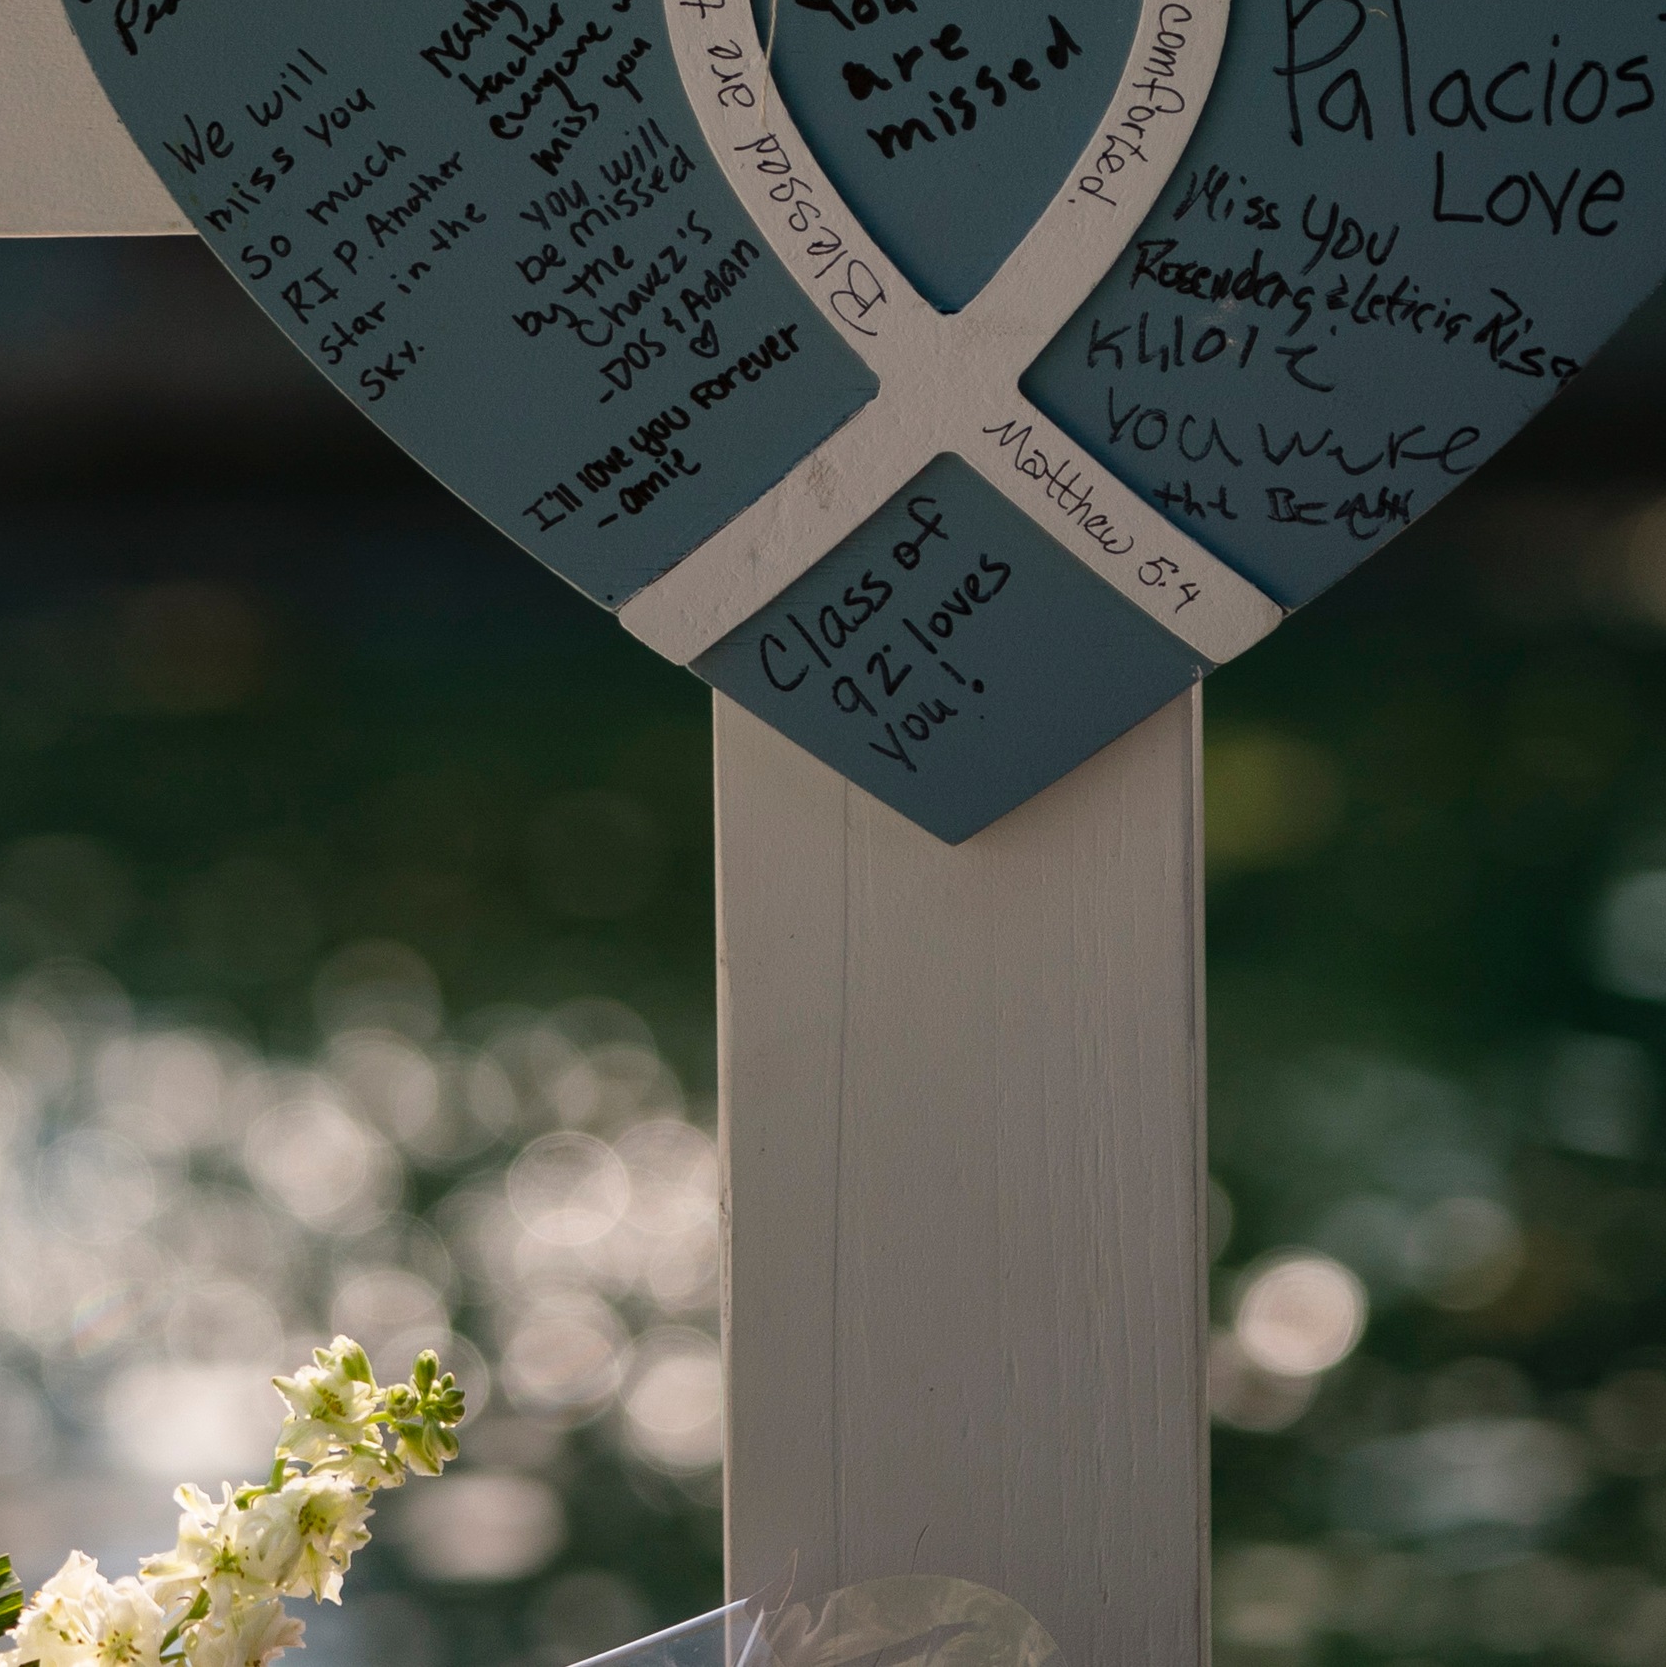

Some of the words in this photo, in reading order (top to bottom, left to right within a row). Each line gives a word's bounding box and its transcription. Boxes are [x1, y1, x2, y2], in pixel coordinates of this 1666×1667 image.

[601, 36, 653, 104] you
[706, 38, 766, 108] are
[841, 23, 970, 101] are
[865, 13, 1085, 160] missed
[162, 113, 235, 174] We
[245, 47, 329, 128] will
[598, 117, 670, 185] will
[204, 146, 296, 233] miss
[305, 140, 407, 226] much
[366, 150, 464, 249] Another
[514, 242, 567, 285] be
[568, 143, 698, 248] missed
[1171, 163, 1283, 233] Miss
[1433, 149, 1626, 237] Love
[389, 260, 432, 295] in
[431, 202, 488, 252] the
[733, 131, 888, 337] Blessed
[510, 302, 581, 337] by
[561, 244, 634, 299] the
[521, 481, 584, 533] I'll
[575, 445, 634, 493] love
[628, 404, 692, 458] you
[981, 419, 1136, 556] Matthew
[758, 568, 894, 693] Class
[893, 496, 950, 571] of
[902, 553, 1013, 655] loves
